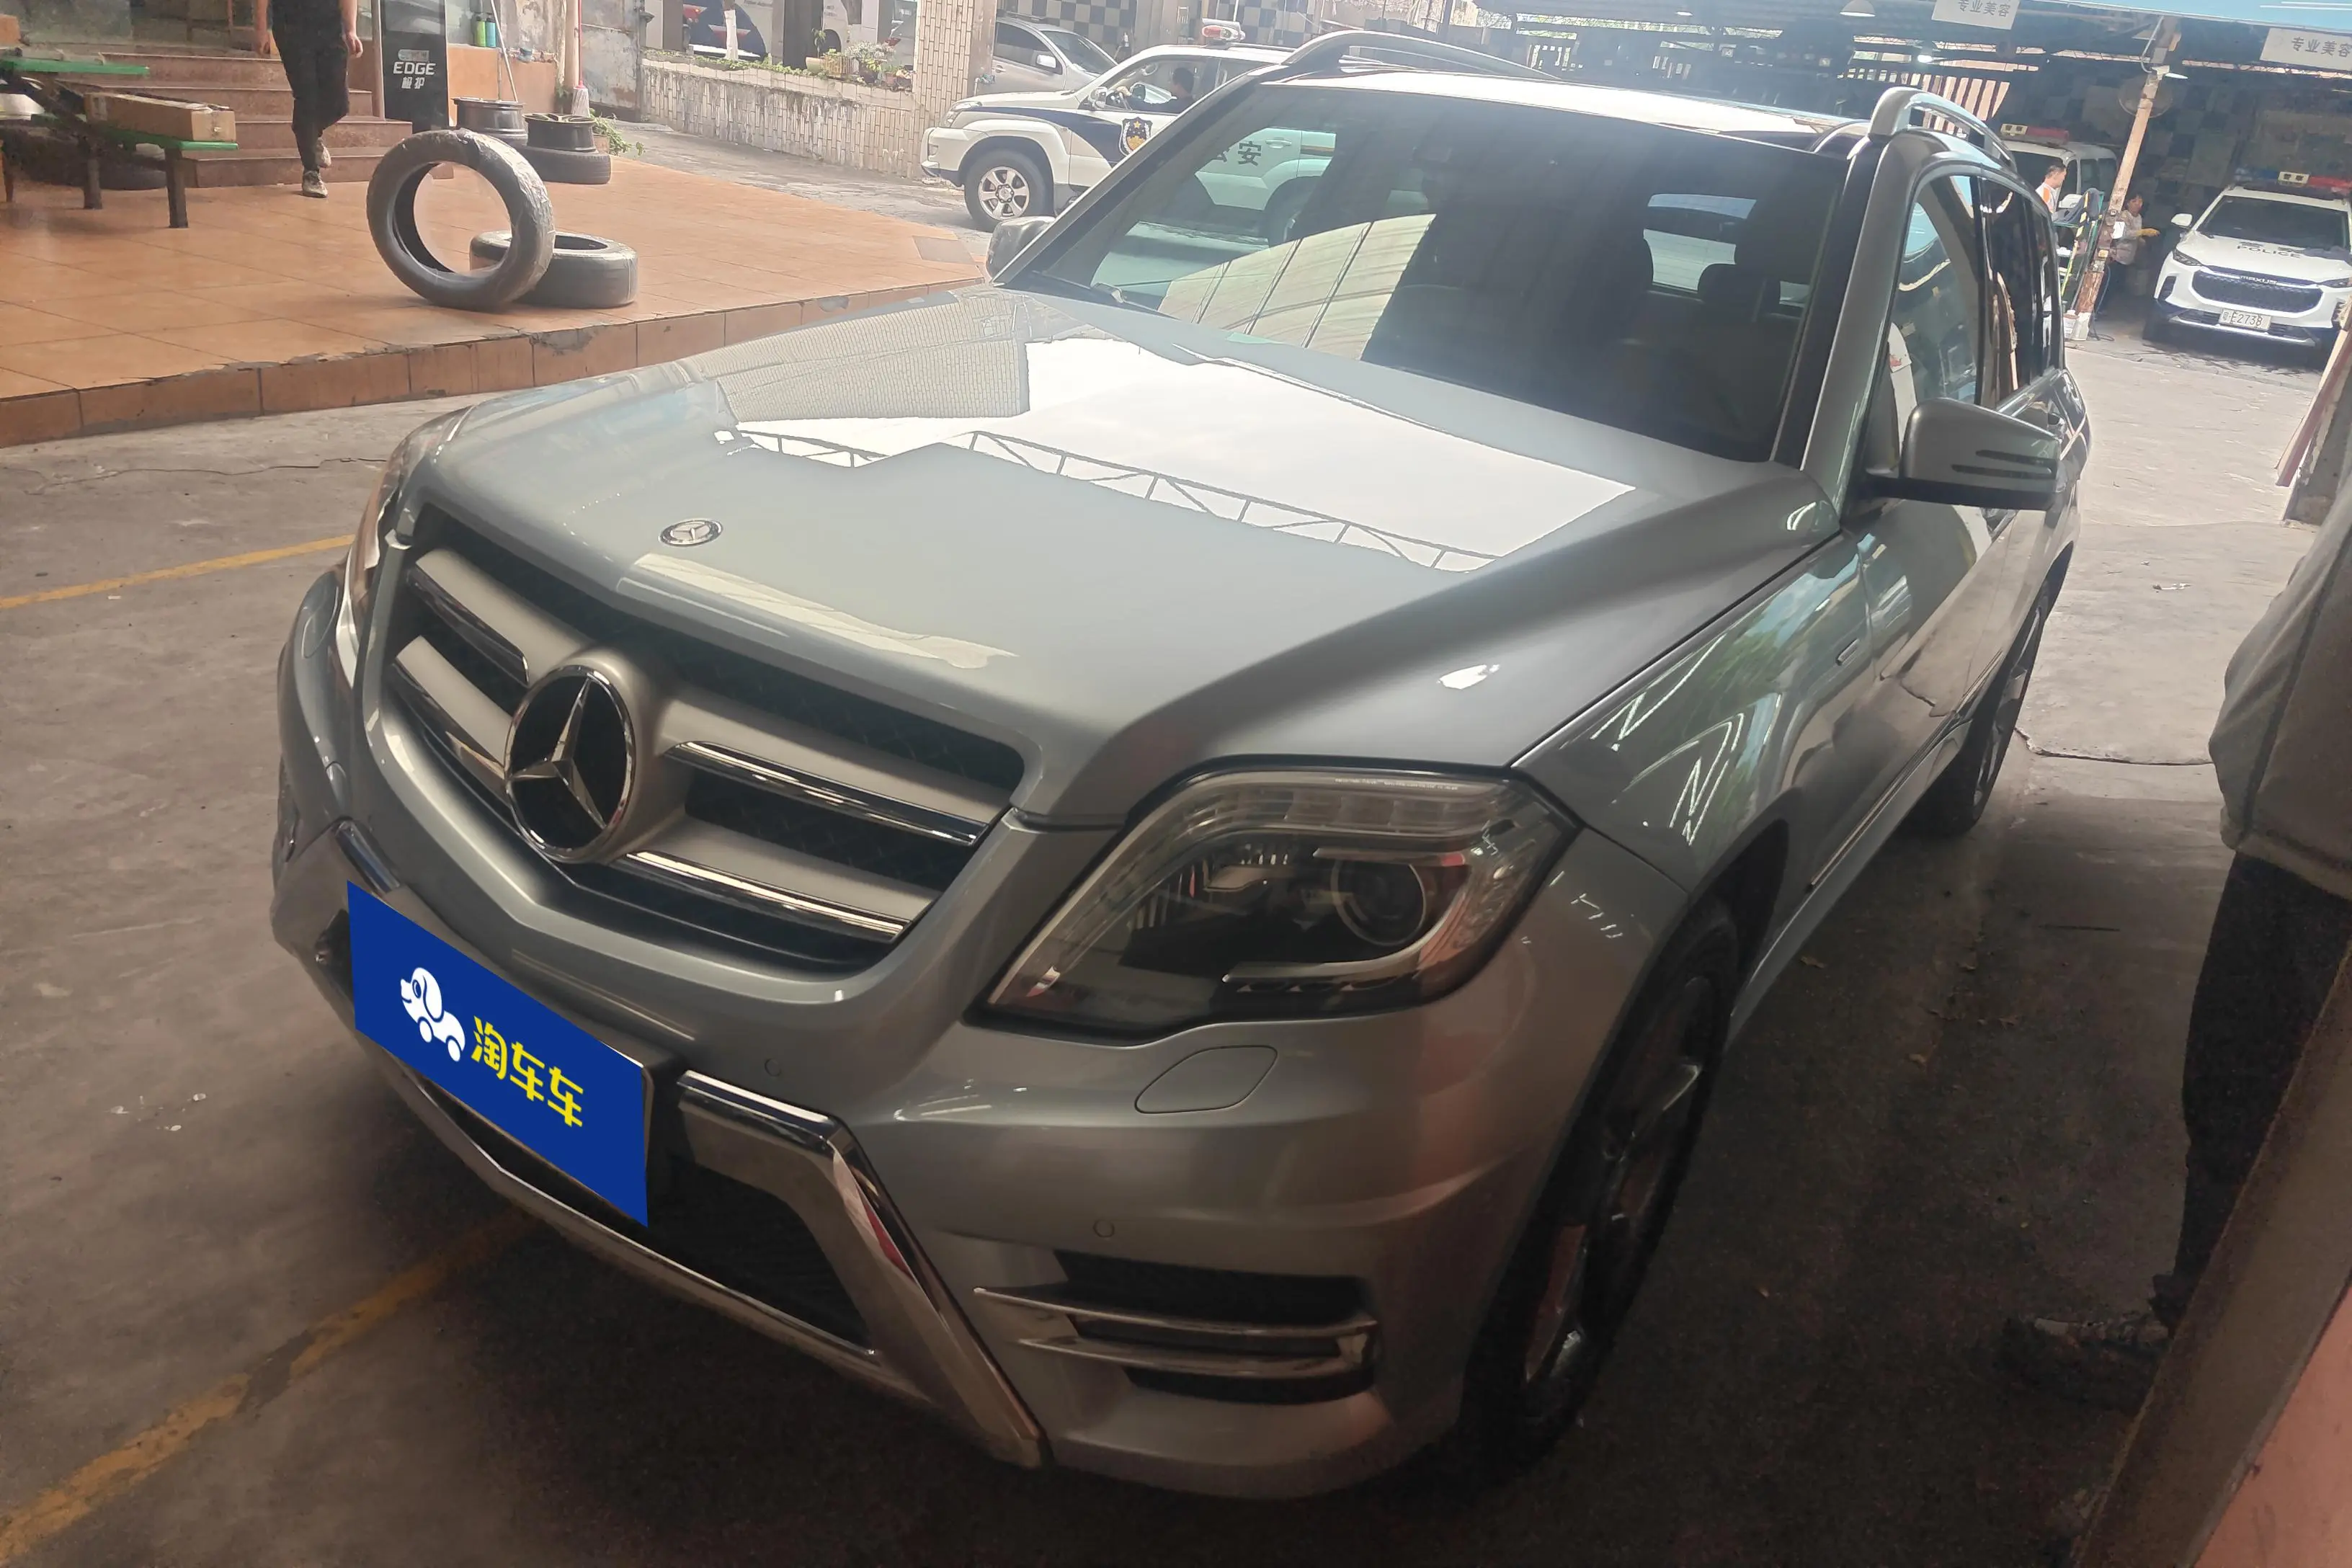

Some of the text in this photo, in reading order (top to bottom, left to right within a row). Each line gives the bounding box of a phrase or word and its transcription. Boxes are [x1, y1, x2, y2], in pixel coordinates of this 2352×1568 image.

[1958, 0, 2011, 17] 专业美容
[2291, 36, 2352, 58] 专业美容
[393, 61, 436, 76] EDGE
[401, 76, 425, 89] 极护
[2237, 244, 2301, 259] POLICE
